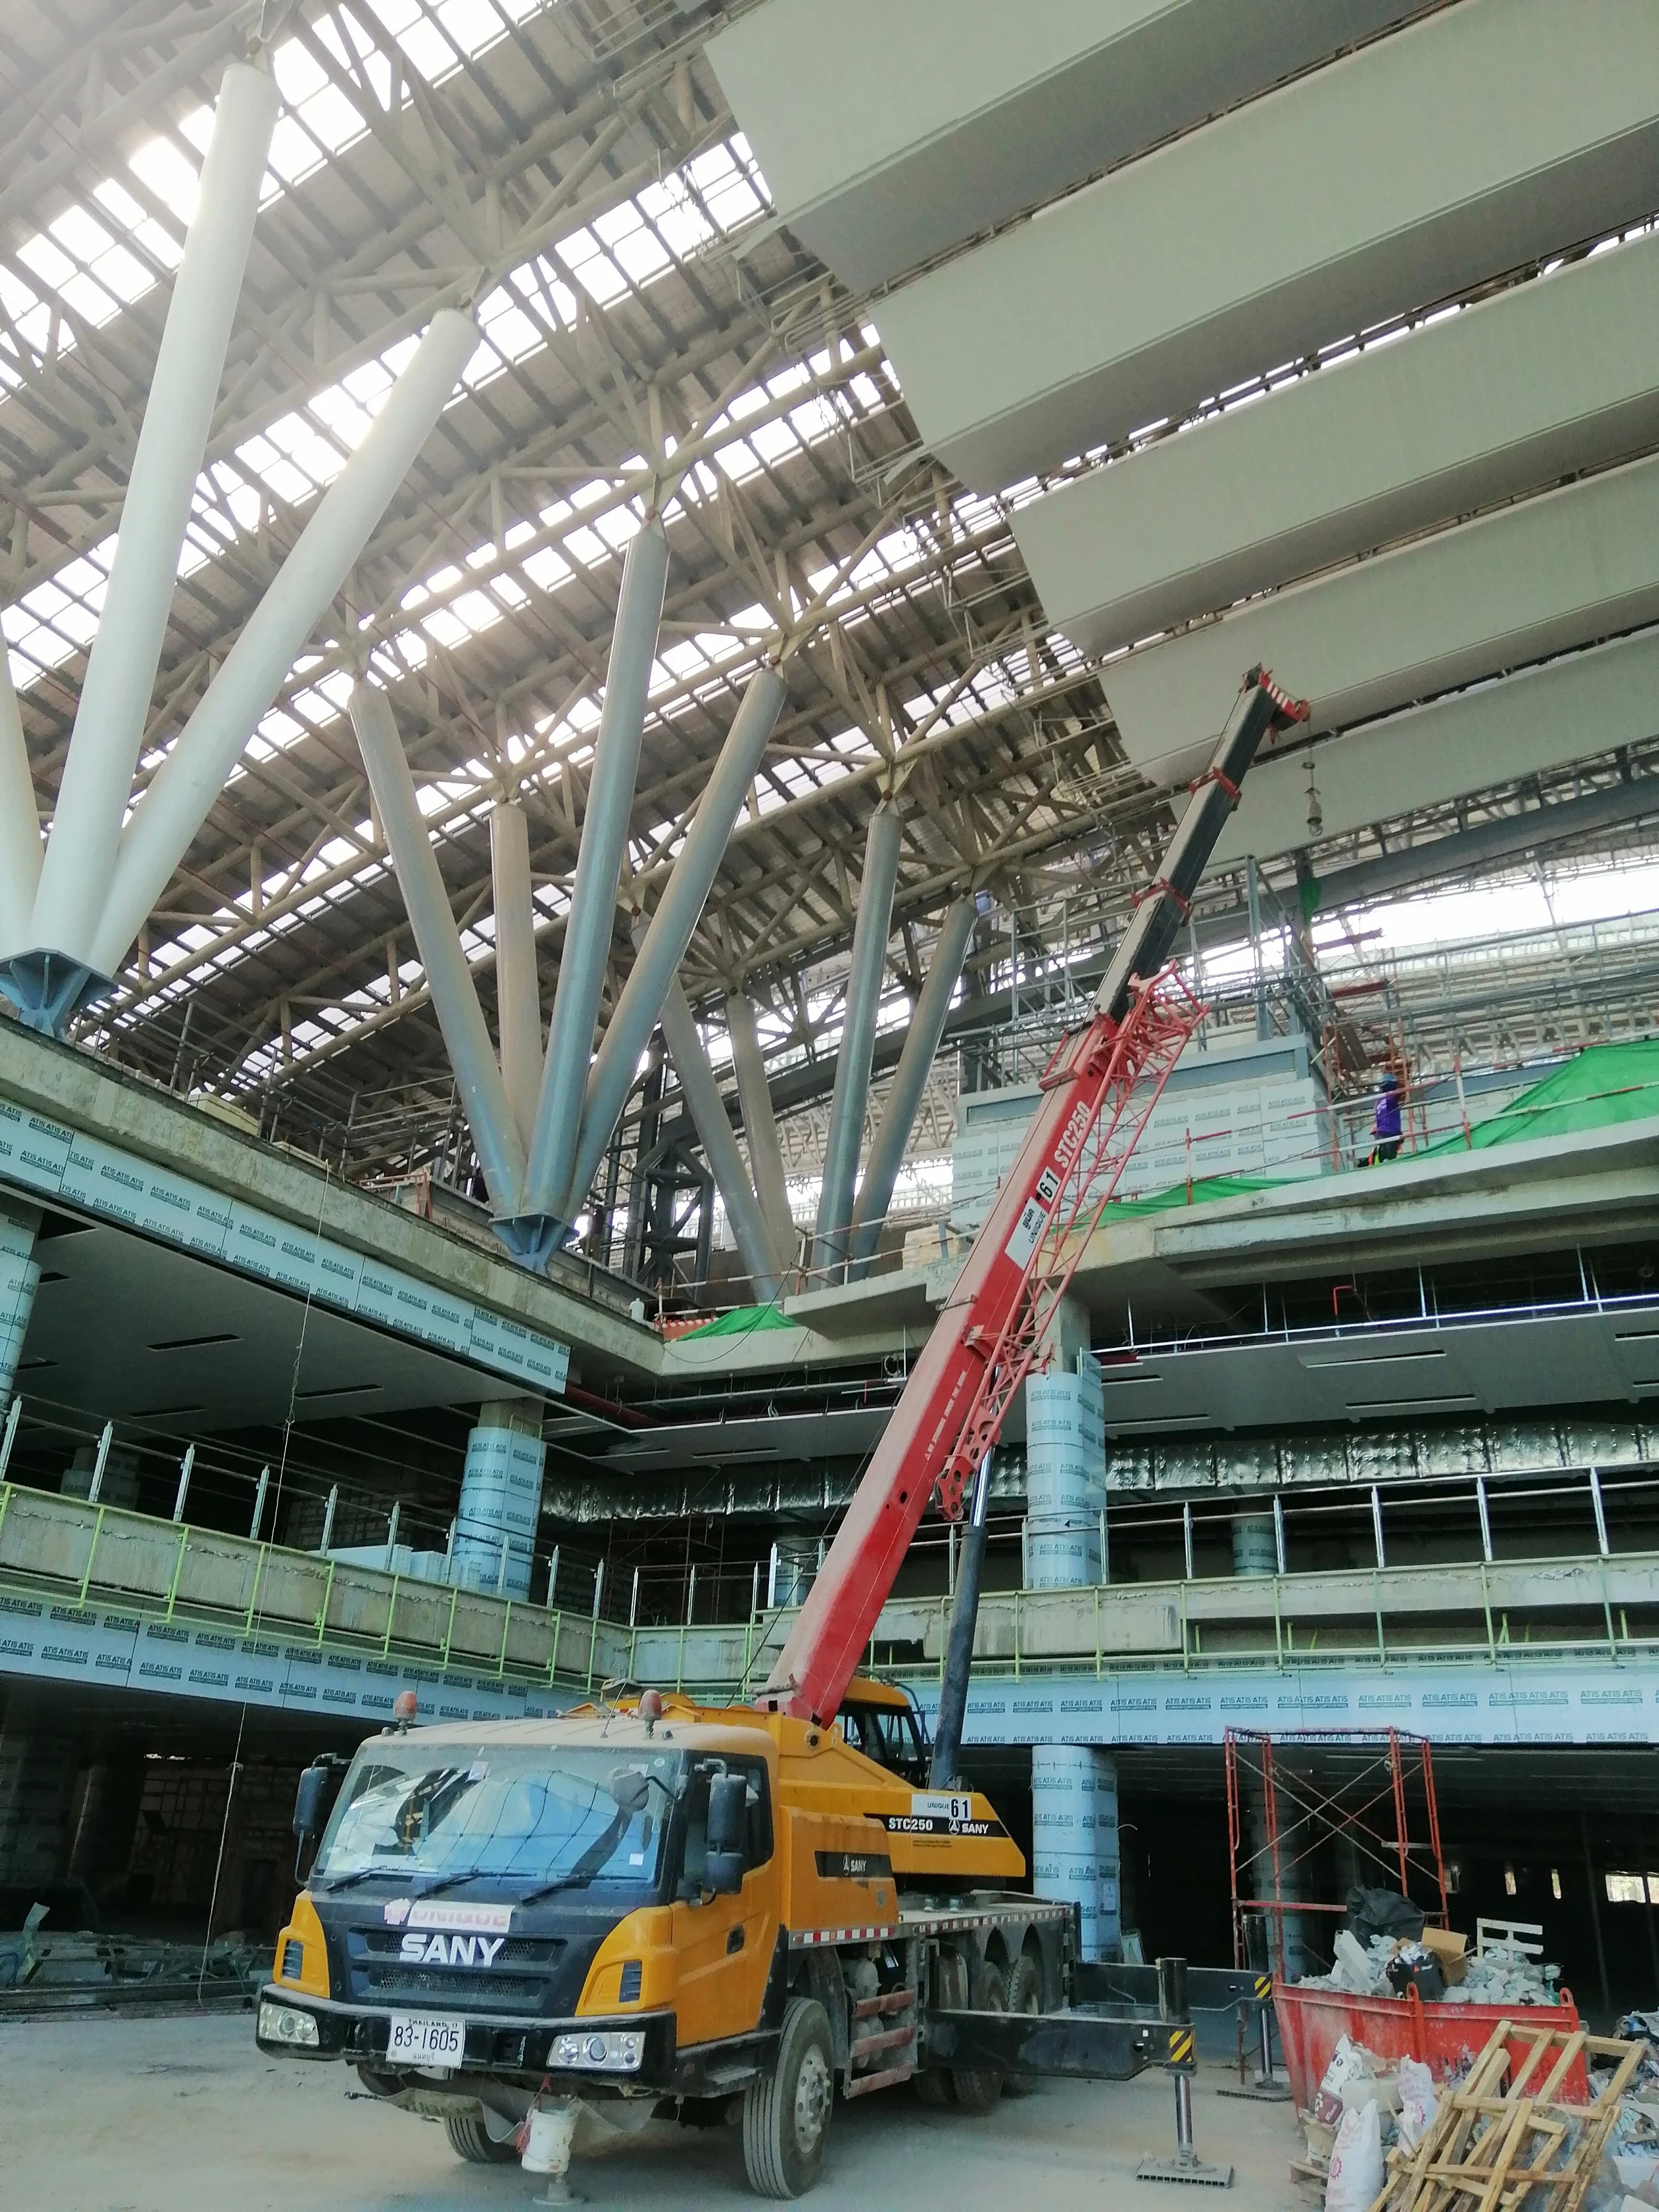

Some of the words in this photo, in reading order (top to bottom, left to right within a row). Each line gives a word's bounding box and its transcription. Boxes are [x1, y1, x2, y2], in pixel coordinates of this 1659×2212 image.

[7, 1107, 22, 1116] ATIS
[30, 1117, 45, 1127] ATIS
[46, 1123, 60, 1134] ATIS
[1054, 1100, 1091, 1169] STC250
[21, 1150, 37, 1160] ATIS
[37, 1157, 53, 1167] ATIS
[81, 1156, 94, 1166] ATIS
[102, 1165, 115, 1175] ATIS
[116, 1171, 130, 1181] ATIS
[131, 1177, 144, 1187] ATIS
[72, 1189, 86, 1199] ATIS
[1039, 1173, 1058, 1199] 61
[151, 1186, 164, 1195] ATIS
[165, 1192, 178, 1201] ATIS
[179, 1197, 191, 1207] ATIS
[94, 1198, 108, 1208] ATIS
[109, 1204, 123, 1214] ATIS
[123, 1210, 137, 1219] ATIS
[198, 1206, 210, 1215] ATIS
[210, 1211, 223, 1221] ATIS
[144, 1218, 157, 1228] ATIS
[157, 1223, 171, 1233] ATIS
[171, 1228, 184, 1238] ATIS
[241, 1224, 253, 1234] ATIS
[253, 1229, 265, 1239] ATIS
[265, 1234, 276, 1244] ATIS
[1029, 1212, 1046, 1244] UNIQUE
[18, 1642, 34, 1651] ATIS
[951, 1799, 968, 1818] 61
[889, 1817, 933, 1831] STC250
[962, 1823, 989, 1834] SANY
[850, 1860, 867, 1872] SANY
[399, 1933, 505, 1968] SANY
[408, 2019, 447, 2028] THAILAND
[394, 2026, 459, 2051] 83-1605
